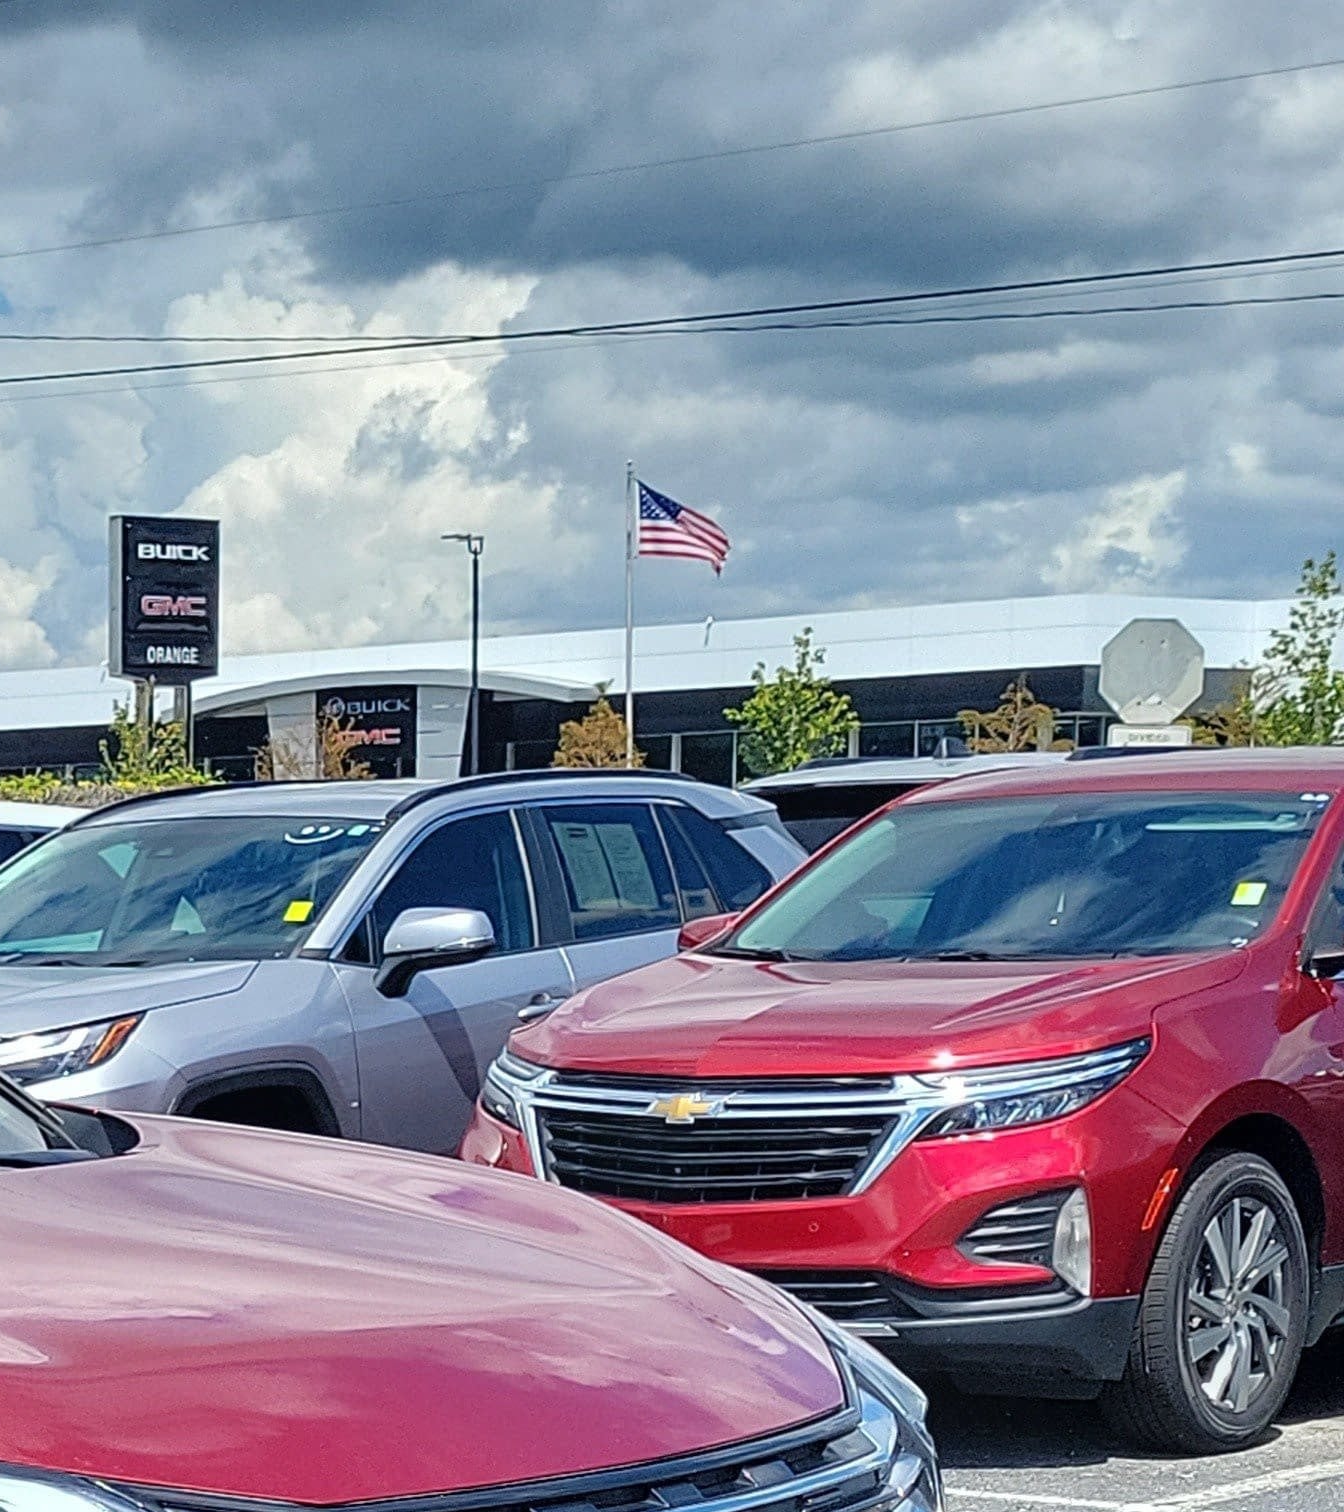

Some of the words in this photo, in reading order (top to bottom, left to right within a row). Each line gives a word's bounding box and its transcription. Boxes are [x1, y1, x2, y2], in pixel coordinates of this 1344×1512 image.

[138, 543, 210, 561] BUICK
[141, 595, 206, 616] GMC
[146, 646, 200, 665] ORANGE
[346, 698, 410, 715] BUICK
